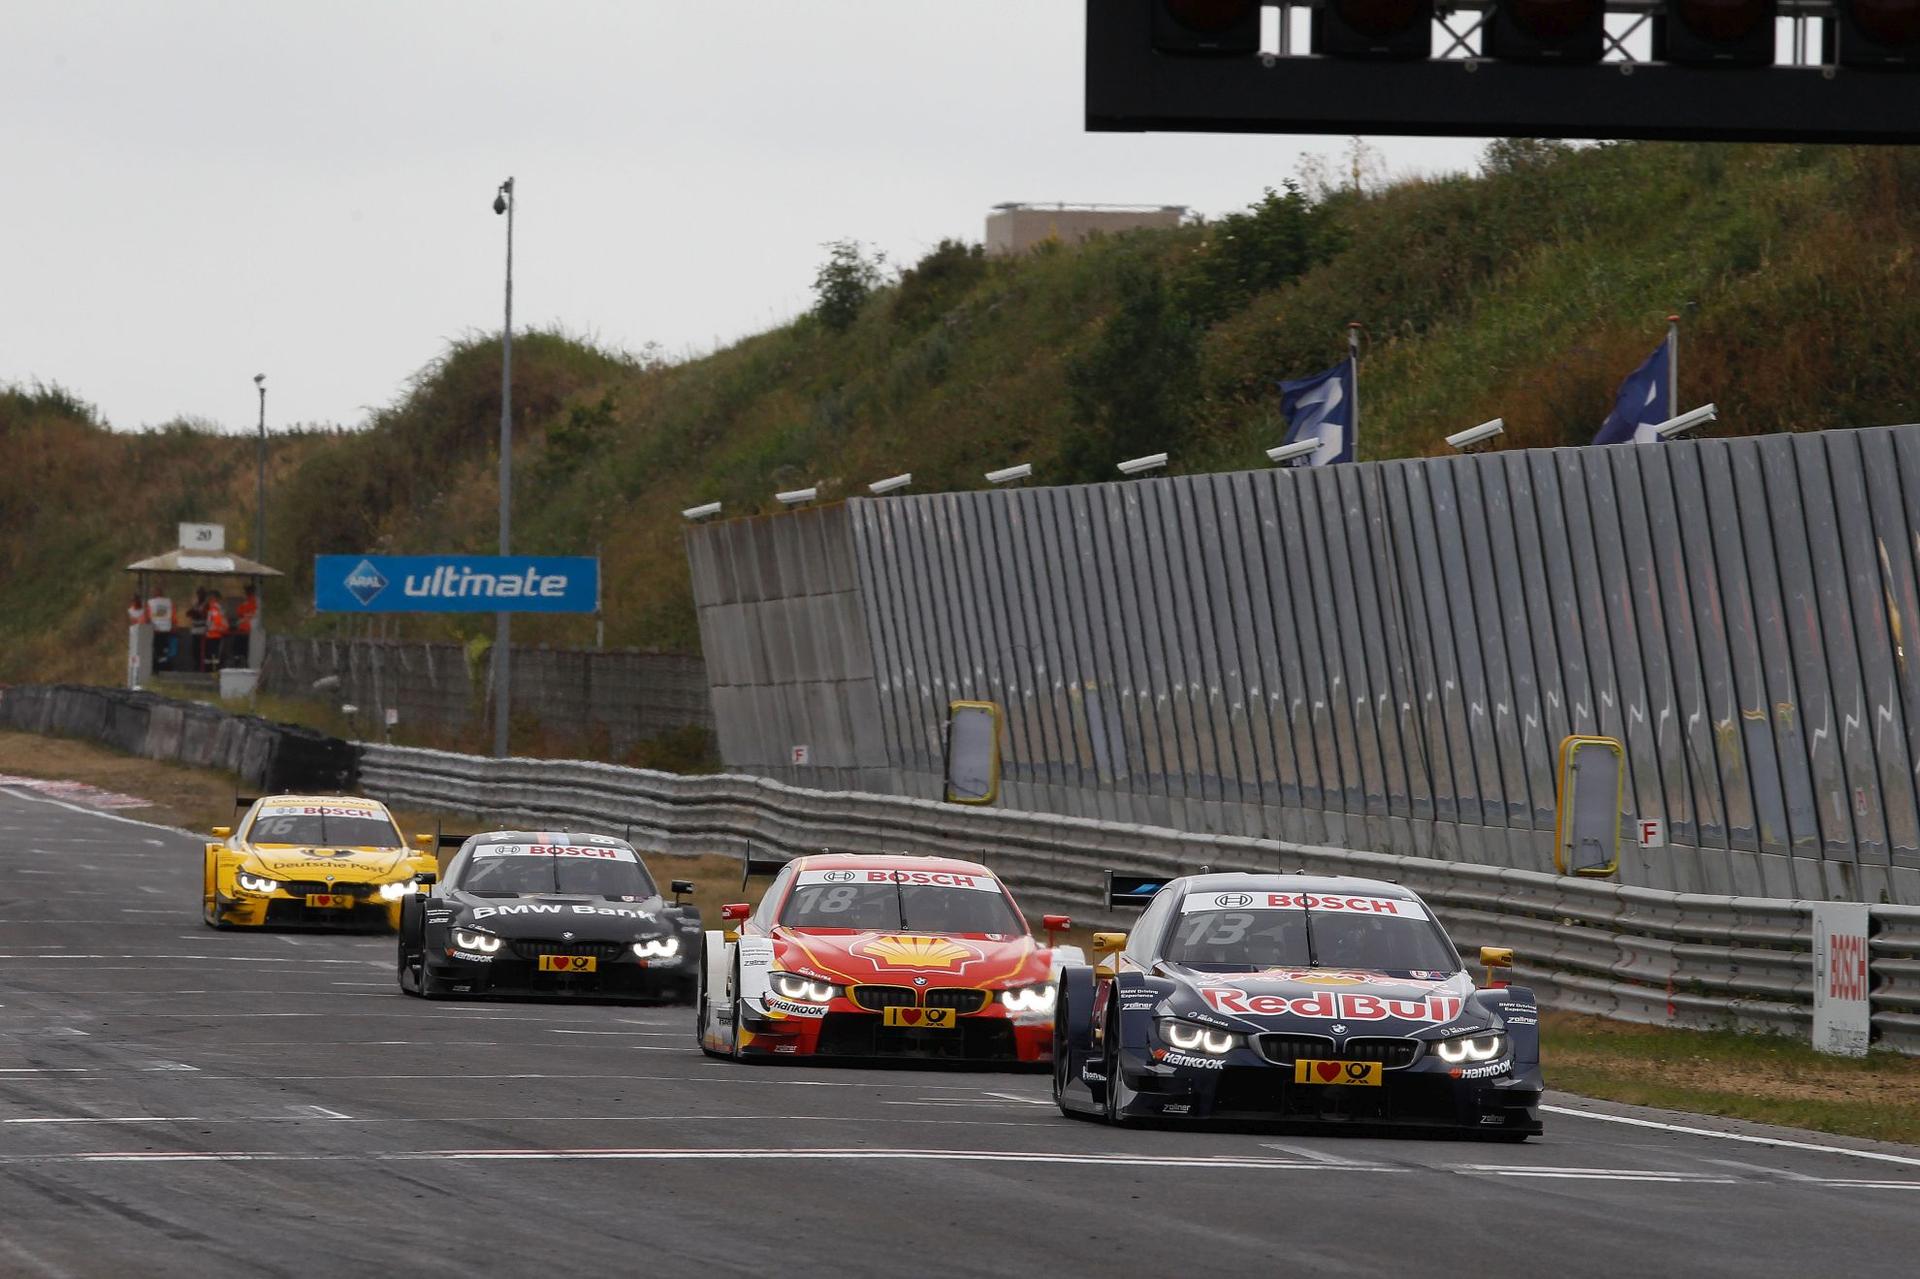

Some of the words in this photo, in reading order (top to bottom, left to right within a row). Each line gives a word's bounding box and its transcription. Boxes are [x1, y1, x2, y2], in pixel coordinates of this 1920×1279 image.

[350, 575, 381, 588] ARAL
[404, 565, 568, 597] ultimate
[794, 748, 805, 762] F
[303, 806, 373, 817] BOSCH
[258, 816, 297, 836] 16
[1643, 822, 1657, 844] F
[529, 845, 617, 858] BOSCH
[273, 861, 347, 870] Deutsche
[350, 862, 386, 873] Post
[467, 857, 506, 884] 7
[867, 871, 976, 887] BOSCH
[799, 886, 857, 914] 18
[1267, 894, 1399, 914] BOSCH
[472, 904, 562, 920] BMW
[571, 905, 657, 923] Bank
[1184, 912, 1256, 947] 13
[1200, 988, 1336, 1019] Red
[1339, 993, 1462, 1021] Bull
